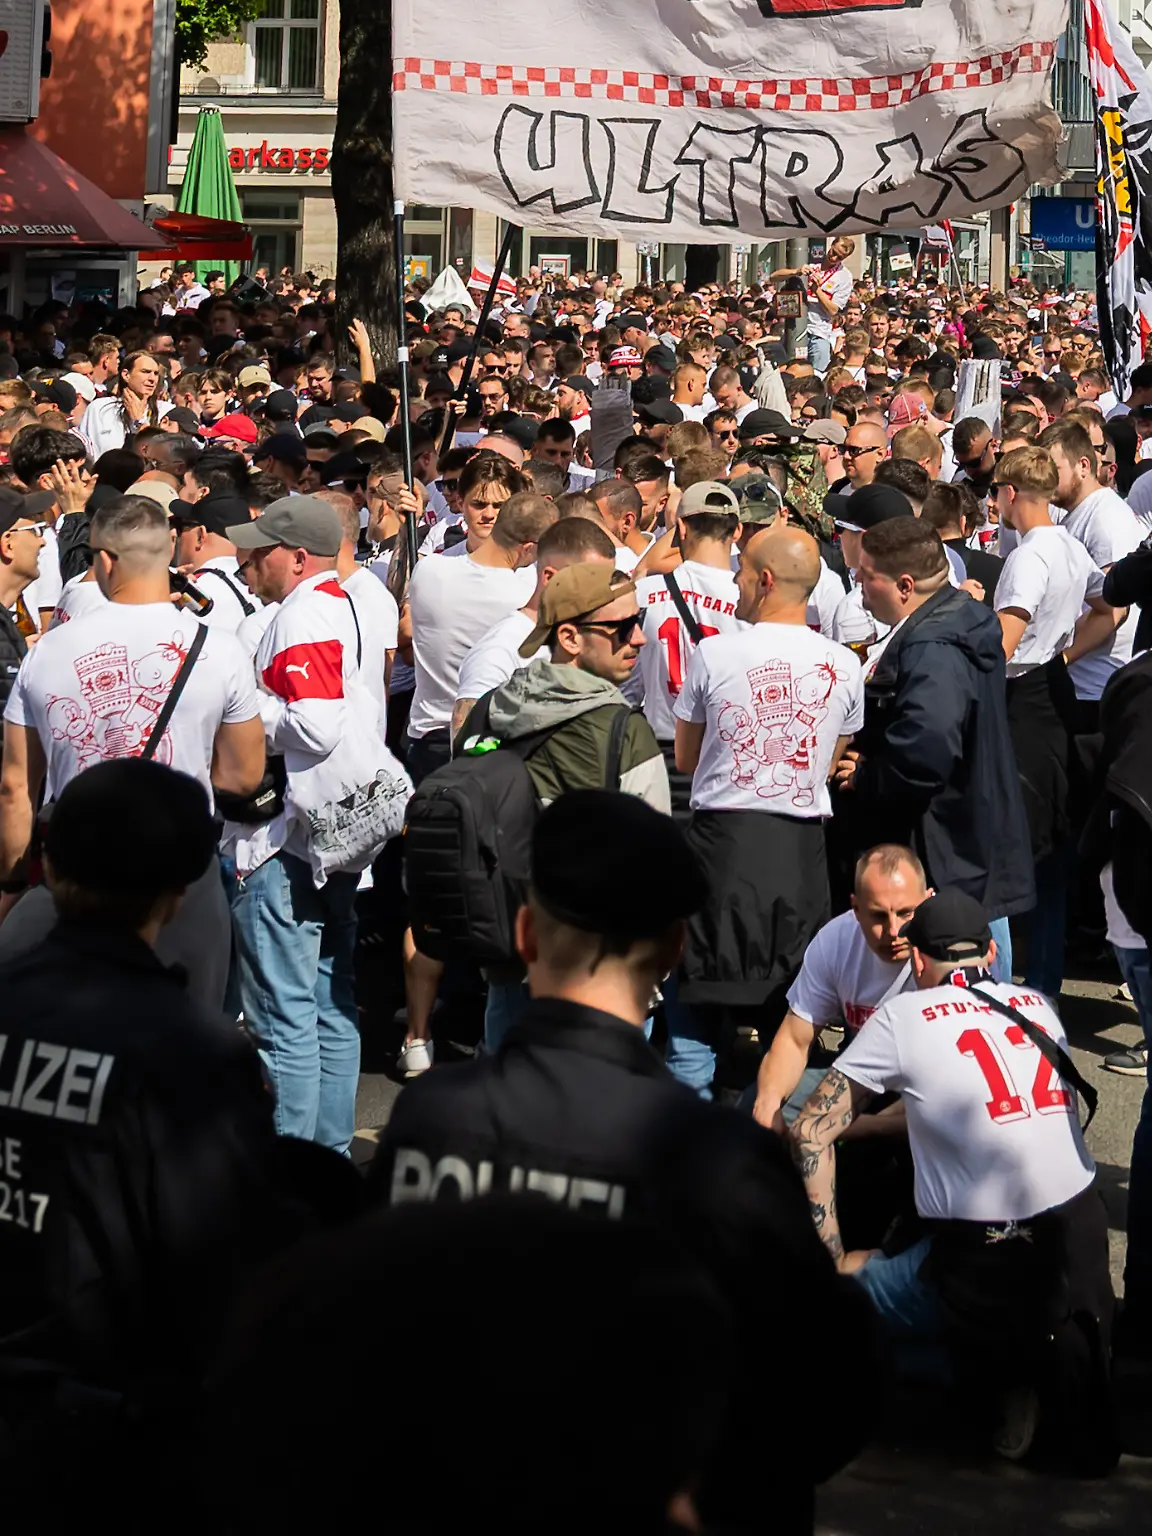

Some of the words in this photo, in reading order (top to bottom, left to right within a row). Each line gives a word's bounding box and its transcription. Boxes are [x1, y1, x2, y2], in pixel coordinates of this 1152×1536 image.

[228, 140, 329, 169] arkass
[494, 102, 1026, 232] ULTRAS
[22, 224, 77, 235] BERLIN
[1075, 204, 1095, 229] U
[648, 590, 735, 617] STTTGAR
[921, 994, 1044, 1022] STUTTART
[956, 1021, 1073, 1126] 12
